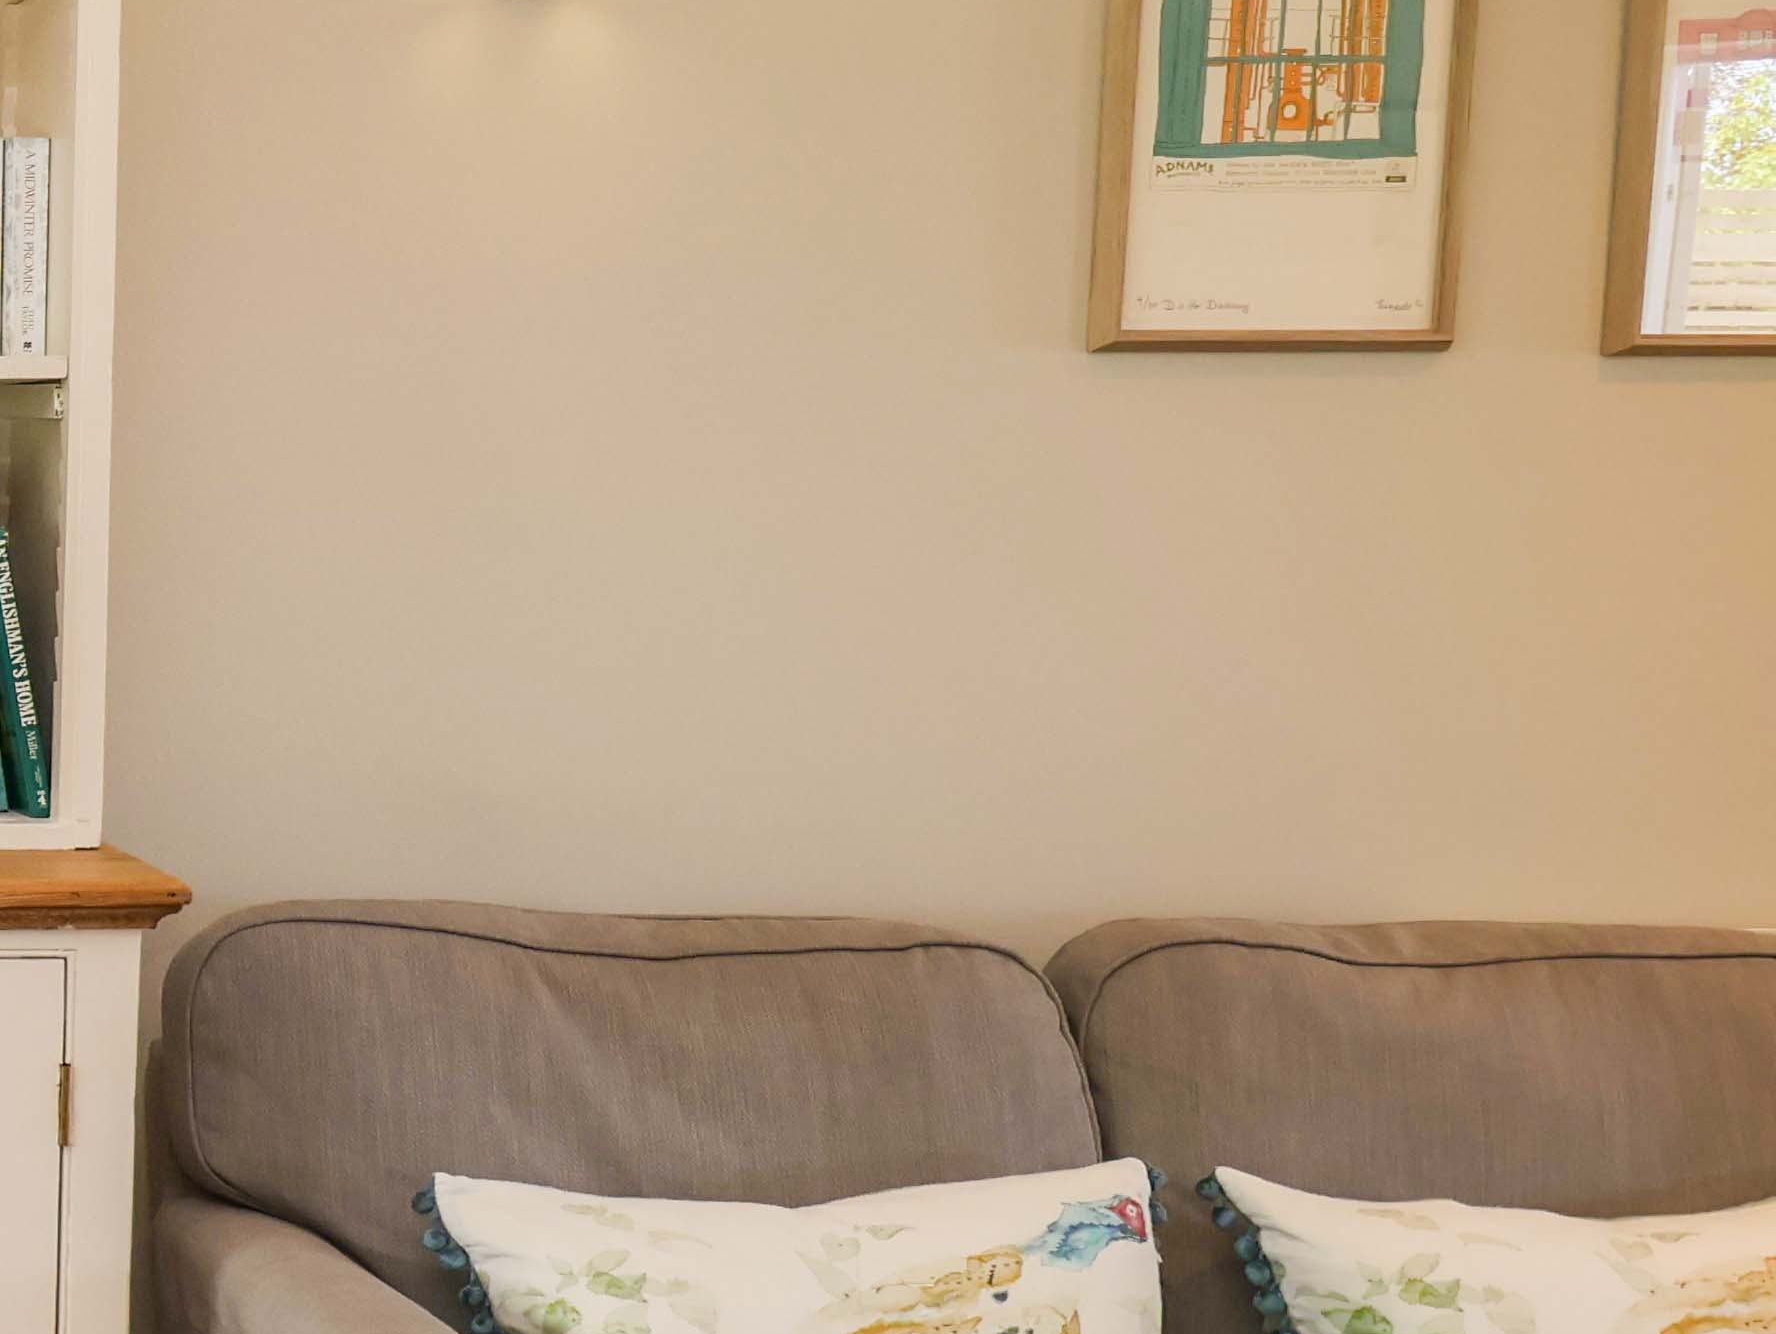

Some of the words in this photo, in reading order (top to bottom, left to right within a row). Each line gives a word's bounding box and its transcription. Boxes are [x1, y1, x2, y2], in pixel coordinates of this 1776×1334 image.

[23, 150, 36, 160] A
[22, 163, 36, 235] MIDWINTER
[22, 241, 36, 297] PROMISE
[15, 680, 37, 727] HOME
